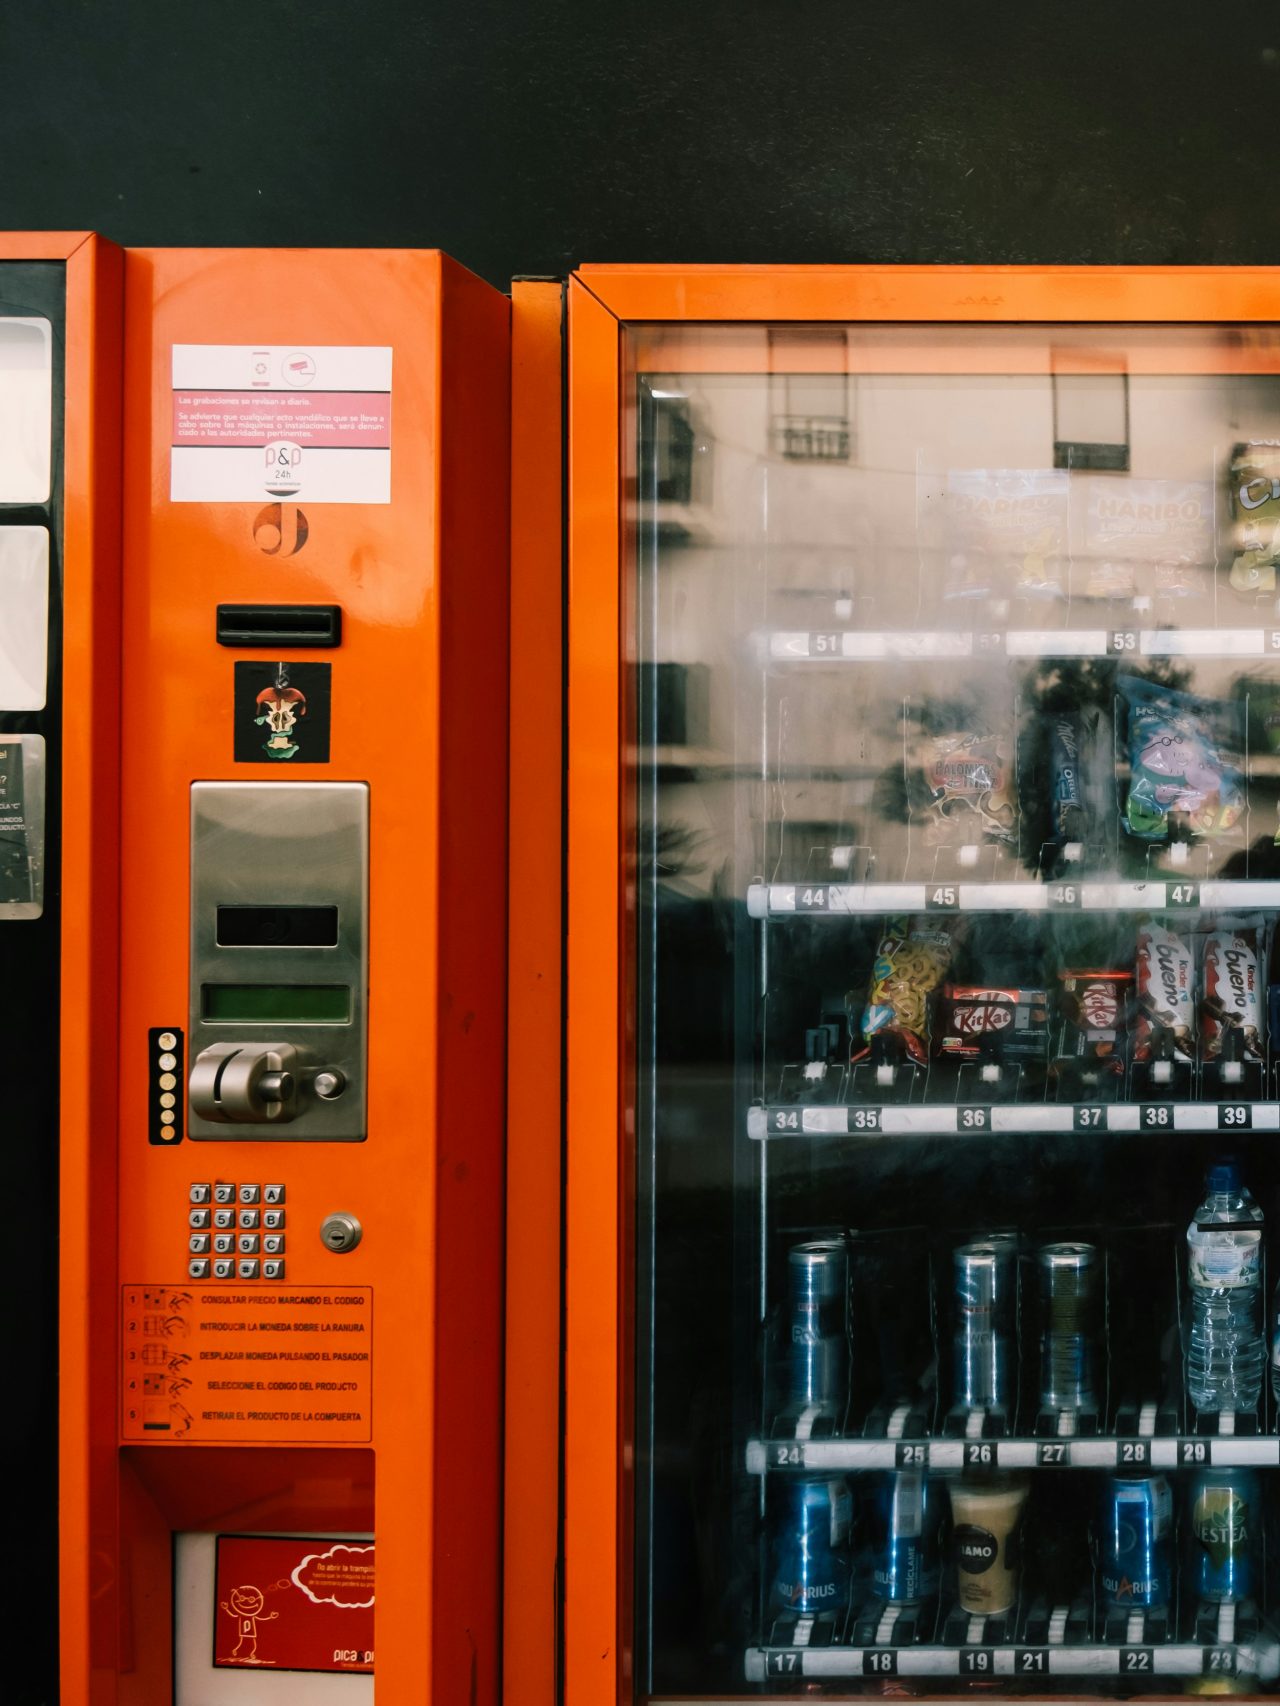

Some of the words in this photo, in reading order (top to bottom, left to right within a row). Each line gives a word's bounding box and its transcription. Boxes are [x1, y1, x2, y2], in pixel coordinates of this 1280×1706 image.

[275, 470, 291, 479] 24h
[1098, 497, 1201, 521] HARIBO
[816, 636, 836, 651] 51
[1114, 634, 1134, 650] 53
[803, 890, 824, 905] 44
[933, 889, 954, 904] 45
[1054, 887, 1075, 903] 46
[1172, 886, 1193, 902] 47
[1155, 943, 1179, 1007] bueno
[1223, 949, 1247, 1009] bueno
[1082, 984, 1117, 1028] KitKat
[960, 1006, 1011, 1034] KitKat
[776, 1113, 798, 1128] 34
[856, 1111, 876, 1128] 35
[963, 1110, 984, 1126] 36
[1080, 1109, 1101, 1125] 37
[1146, 1108, 1168, 1125] 38
[1225, 1108, 1246, 1124] 39
[218, 1191, 225, 1199] 2
[243, 1191, 250, 1200] 3
[267, 1191, 275, 1200] A
[193, 1216, 200, 1224] 4
[218, 1215, 225, 1224] 5
[243, 1216, 250, 1225] 6
[267, 1216, 275, 1224] B
[193, 1240, 200, 1248] 7
[217, 1240, 225, 1249] 8
[242, 1240, 249, 1249] 9
[267, 1240, 275, 1249] C
[217, 1265, 225, 1274] 0
[266, 1265, 274, 1274] D
[130, 1296, 136, 1304] 1
[201, 1296, 247, 1304] CONSULTAR
[248, 1296, 277, 1304] PRECIO
[278, 1296, 321, 1304] MARCANDO
[323, 1296, 333, 1304] EL
[334, 1296, 365, 1304] CODIGO
[129, 1322, 137, 1331] 2
[200, 1323, 246, 1331] INTRODUCIR
[247, 1323, 257, 1331] LA
[259, 1323, 292, 1331] MONEDA
[293, 1323, 320, 1331] SOBRE
[321, 1323, 331, 1331] LA
[332, 1323, 365, 1331] RANURA
[129, 1351, 136, 1360] 3
[200, 1352, 244, 1360] DESPLAZAR
[246, 1352, 278, 1360] MONEDA
[279, 1352, 320, 1360] PULSANDO
[321, 1352, 331, 1360] EL
[333, 1352, 369, 1360] PASADOR
[129, 1381, 136, 1390] 4
[207, 1382, 255, 1390] SELECCIONE
[256, 1382, 266, 1390] EL
[267, 1382, 298, 1390] CODIGO
[299, 1382, 314, 1390] DEL
[129, 1411, 136, 1419] 5
[202, 1412, 235, 1420] RETIRAR
[236, 1412, 246, 1420] EL
[247, 1412, 290, 1420] PRODUCTO
[290, 1412, 301, 1420] DE
[303, 1412, 313, 1420] LA
[314, 1412, 362, 1420] COMPUERTA
[778, 1448, 800, 1465] 24
[904, 1448, 924, 1464] 25
[970, 1446, 991, 1463] 26
[1043, 1446, 1064, 1462] 27
[1124, 1446, 1144, 1462] 28
[1184, 1445, 1205, 1461] 29
[776, 1655, 795, 1671] 17
[871, 1655, 891, 1671] 18
[967, 1654, 988, 1670] 19
[1023, 1654, 1043, 1670] 21
[1127, 1654, 1148, 1670] 22
